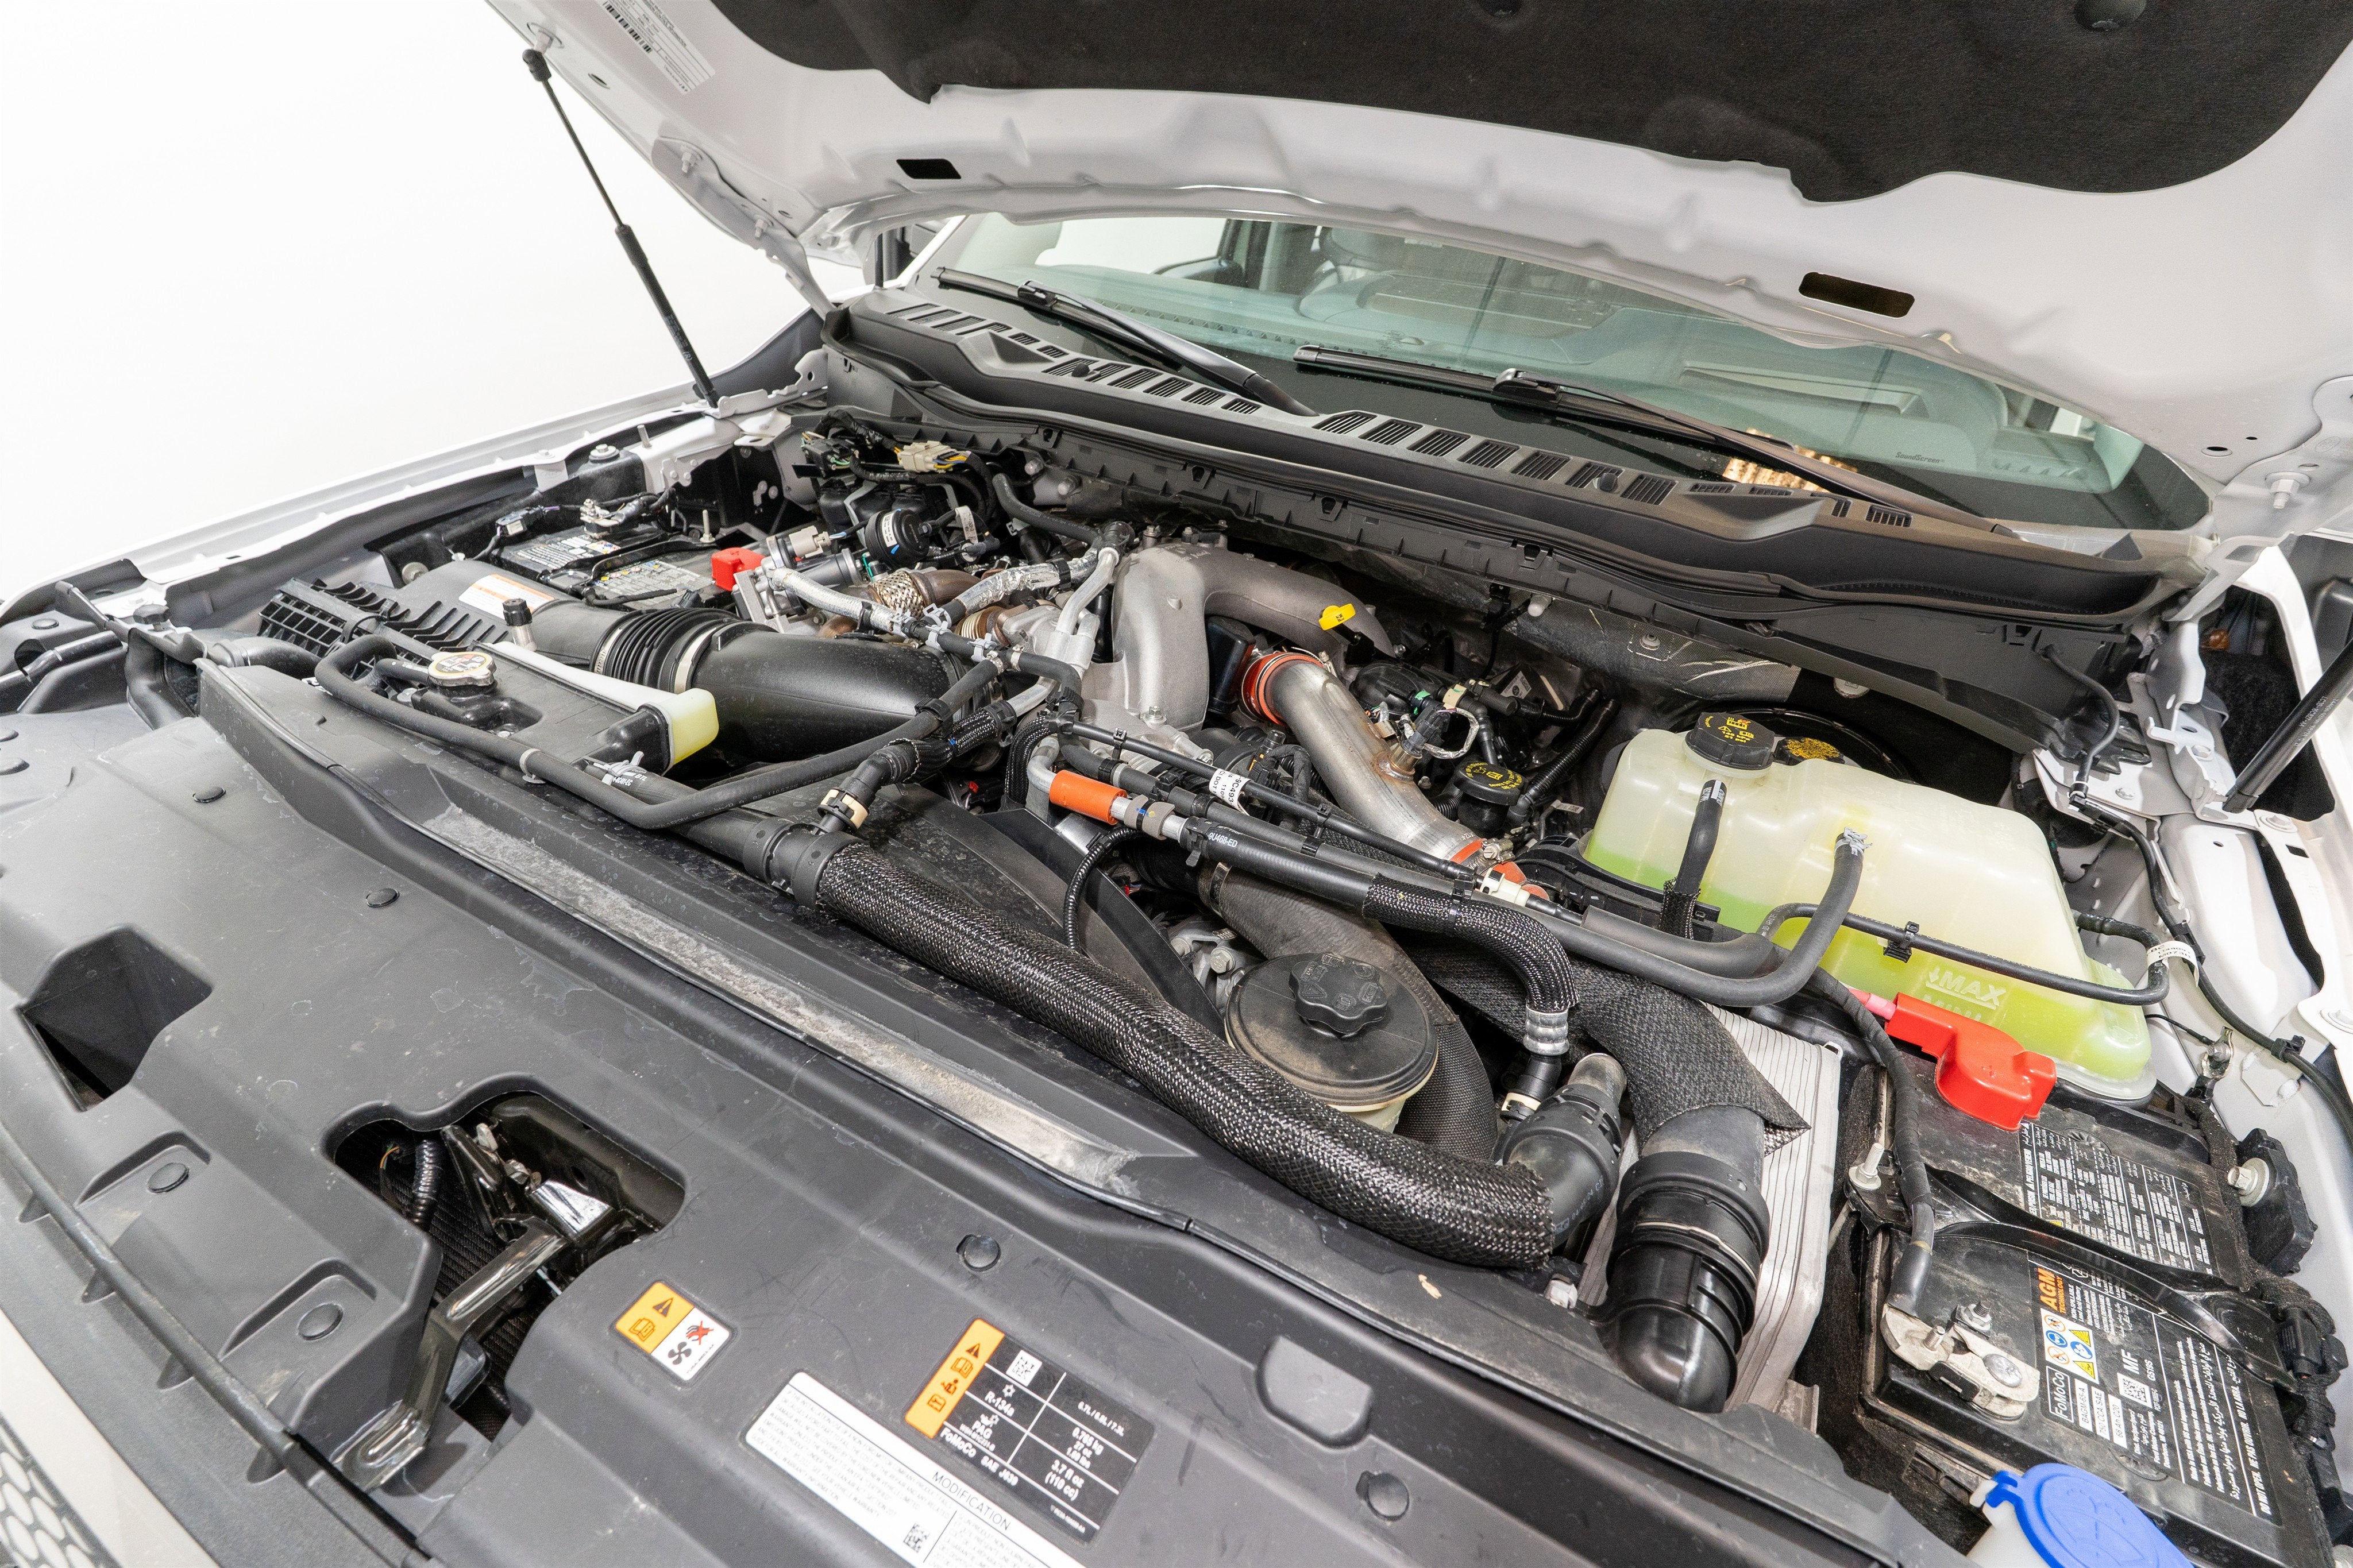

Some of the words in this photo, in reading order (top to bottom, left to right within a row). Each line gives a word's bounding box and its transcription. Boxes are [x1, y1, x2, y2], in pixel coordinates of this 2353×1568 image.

[1213, 776, 1221, 790] DOT
[1939, 970, 2006, 1006] MAX
[2036, 1265, 2059, 1311] AGM
[2055, 1274, 2066, 1315] TECHNOLOGY
[2120, 1347, 2140, 1376] MF
[2143, 1357, 2157, 1382] G519S
[983, 1389, 1017, 1417] R-134a
[2051, 1368, 2069, 1419] FoMoCo
[2229, 1382, 2243, 1403] ABRA.
[2112, 1403, 2120, 1418] C20
[2235, 1400, 2245, 1411] LA
[2236, 1408, 2247, 1420] NO
[970, 1419, 994, 1440] PAG
[2098, 1421, 2107, 1435] 750
[2113, 1417, 2121, 1429] Ah
[2239, 1419, 2254, 1447] OUVRIR.
[938, 1426, 979, 1459] FoMoCo
[979, 1454, 1000, 1473] SAE
[1089, 1438, 1106, 1457] kg
[2149, 1434, 2158, 1451] Motor
[2245, 1443, 2257, 1459] PAS
[2152, 1449, 2161, 1465] Ford
[2159, 1440, 2171, 1469] Dearborn,
[2248, 1456, 2260, 1469] NE
[1043, 1470, 1067, 1493] (110
[1049, 1459, 1068, 1477] 3.7
[1070, 1473, 1086, 1489] oz
[2251, 1468, 2265, 1490] OPEN.
[929, 1470, 1013, 1532] MODIFICATION
[2255, 1487, 2269, 1505] NOT
[2259, 1501, 2271, 1515] DO
